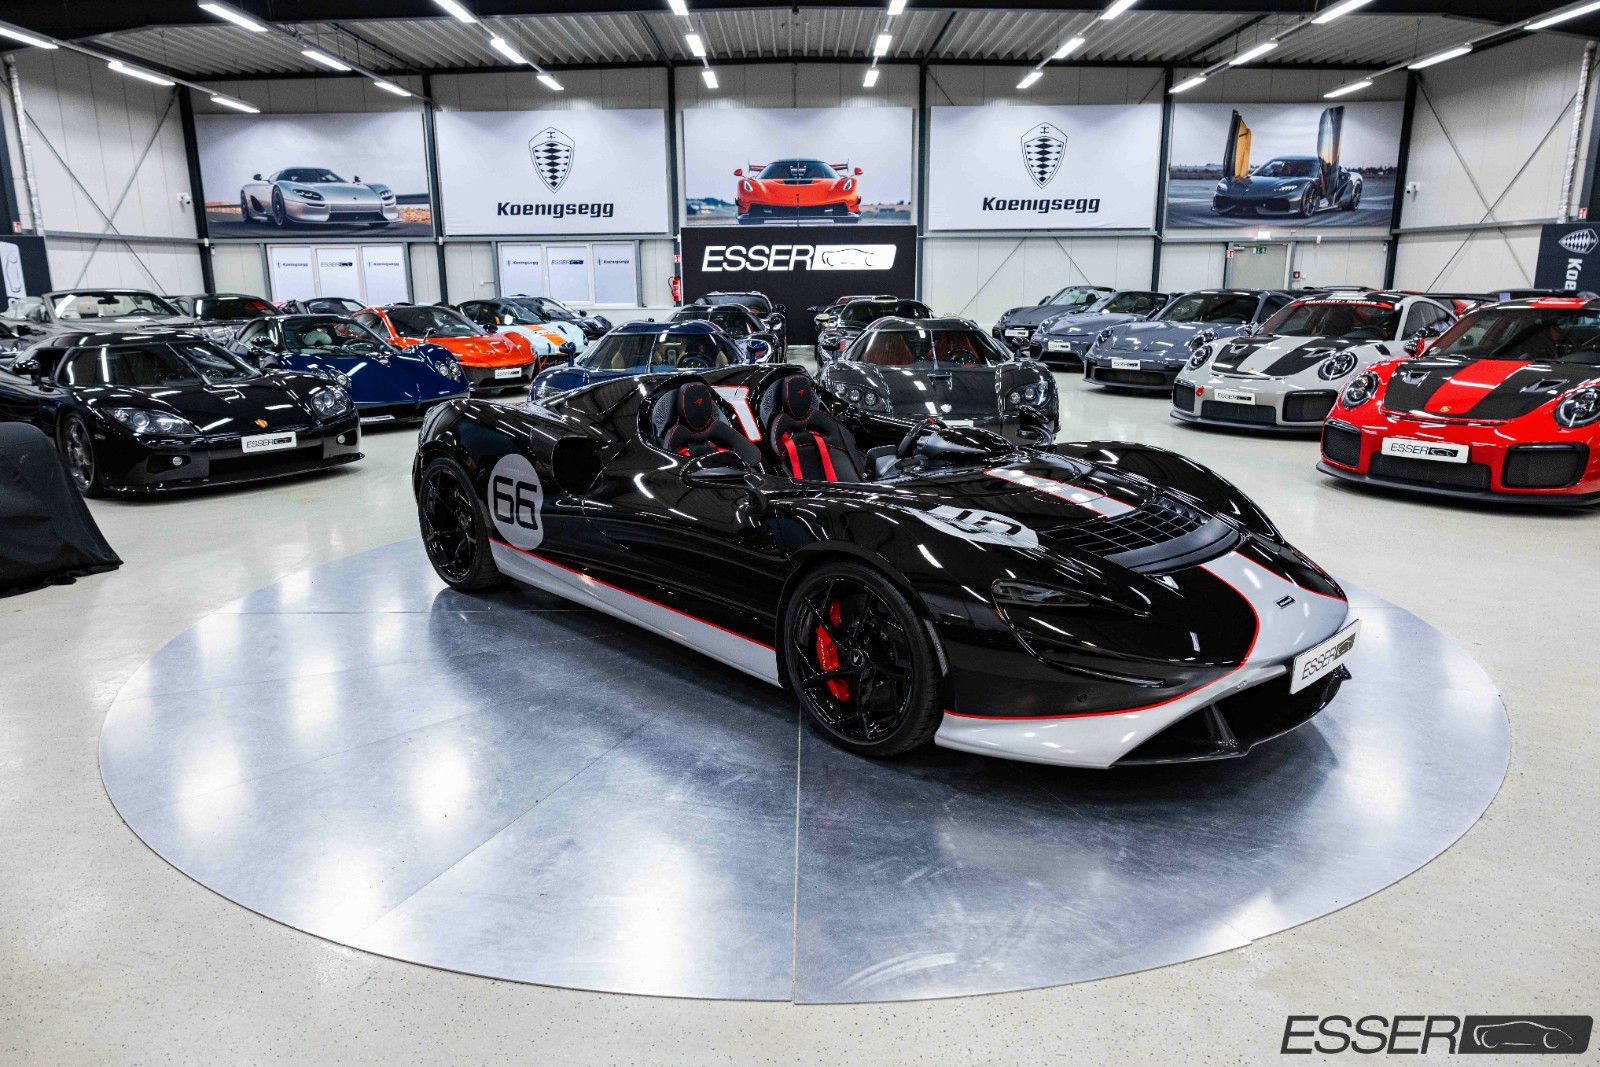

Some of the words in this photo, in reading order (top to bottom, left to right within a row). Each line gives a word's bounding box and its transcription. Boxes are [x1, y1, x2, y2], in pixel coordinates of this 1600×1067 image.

[497, 202, 614, 219] Koenigsegg
[982, 197, 1101, 214] Koenigsegg
[702, 244, 814, 272] ESSER
[246, 438, 274, 449] ESSER
[1390, 442, 1429, 455] ESSER
[493, 474, 539, 531] 66
[1302, 646, 1337, 680] ESSER
